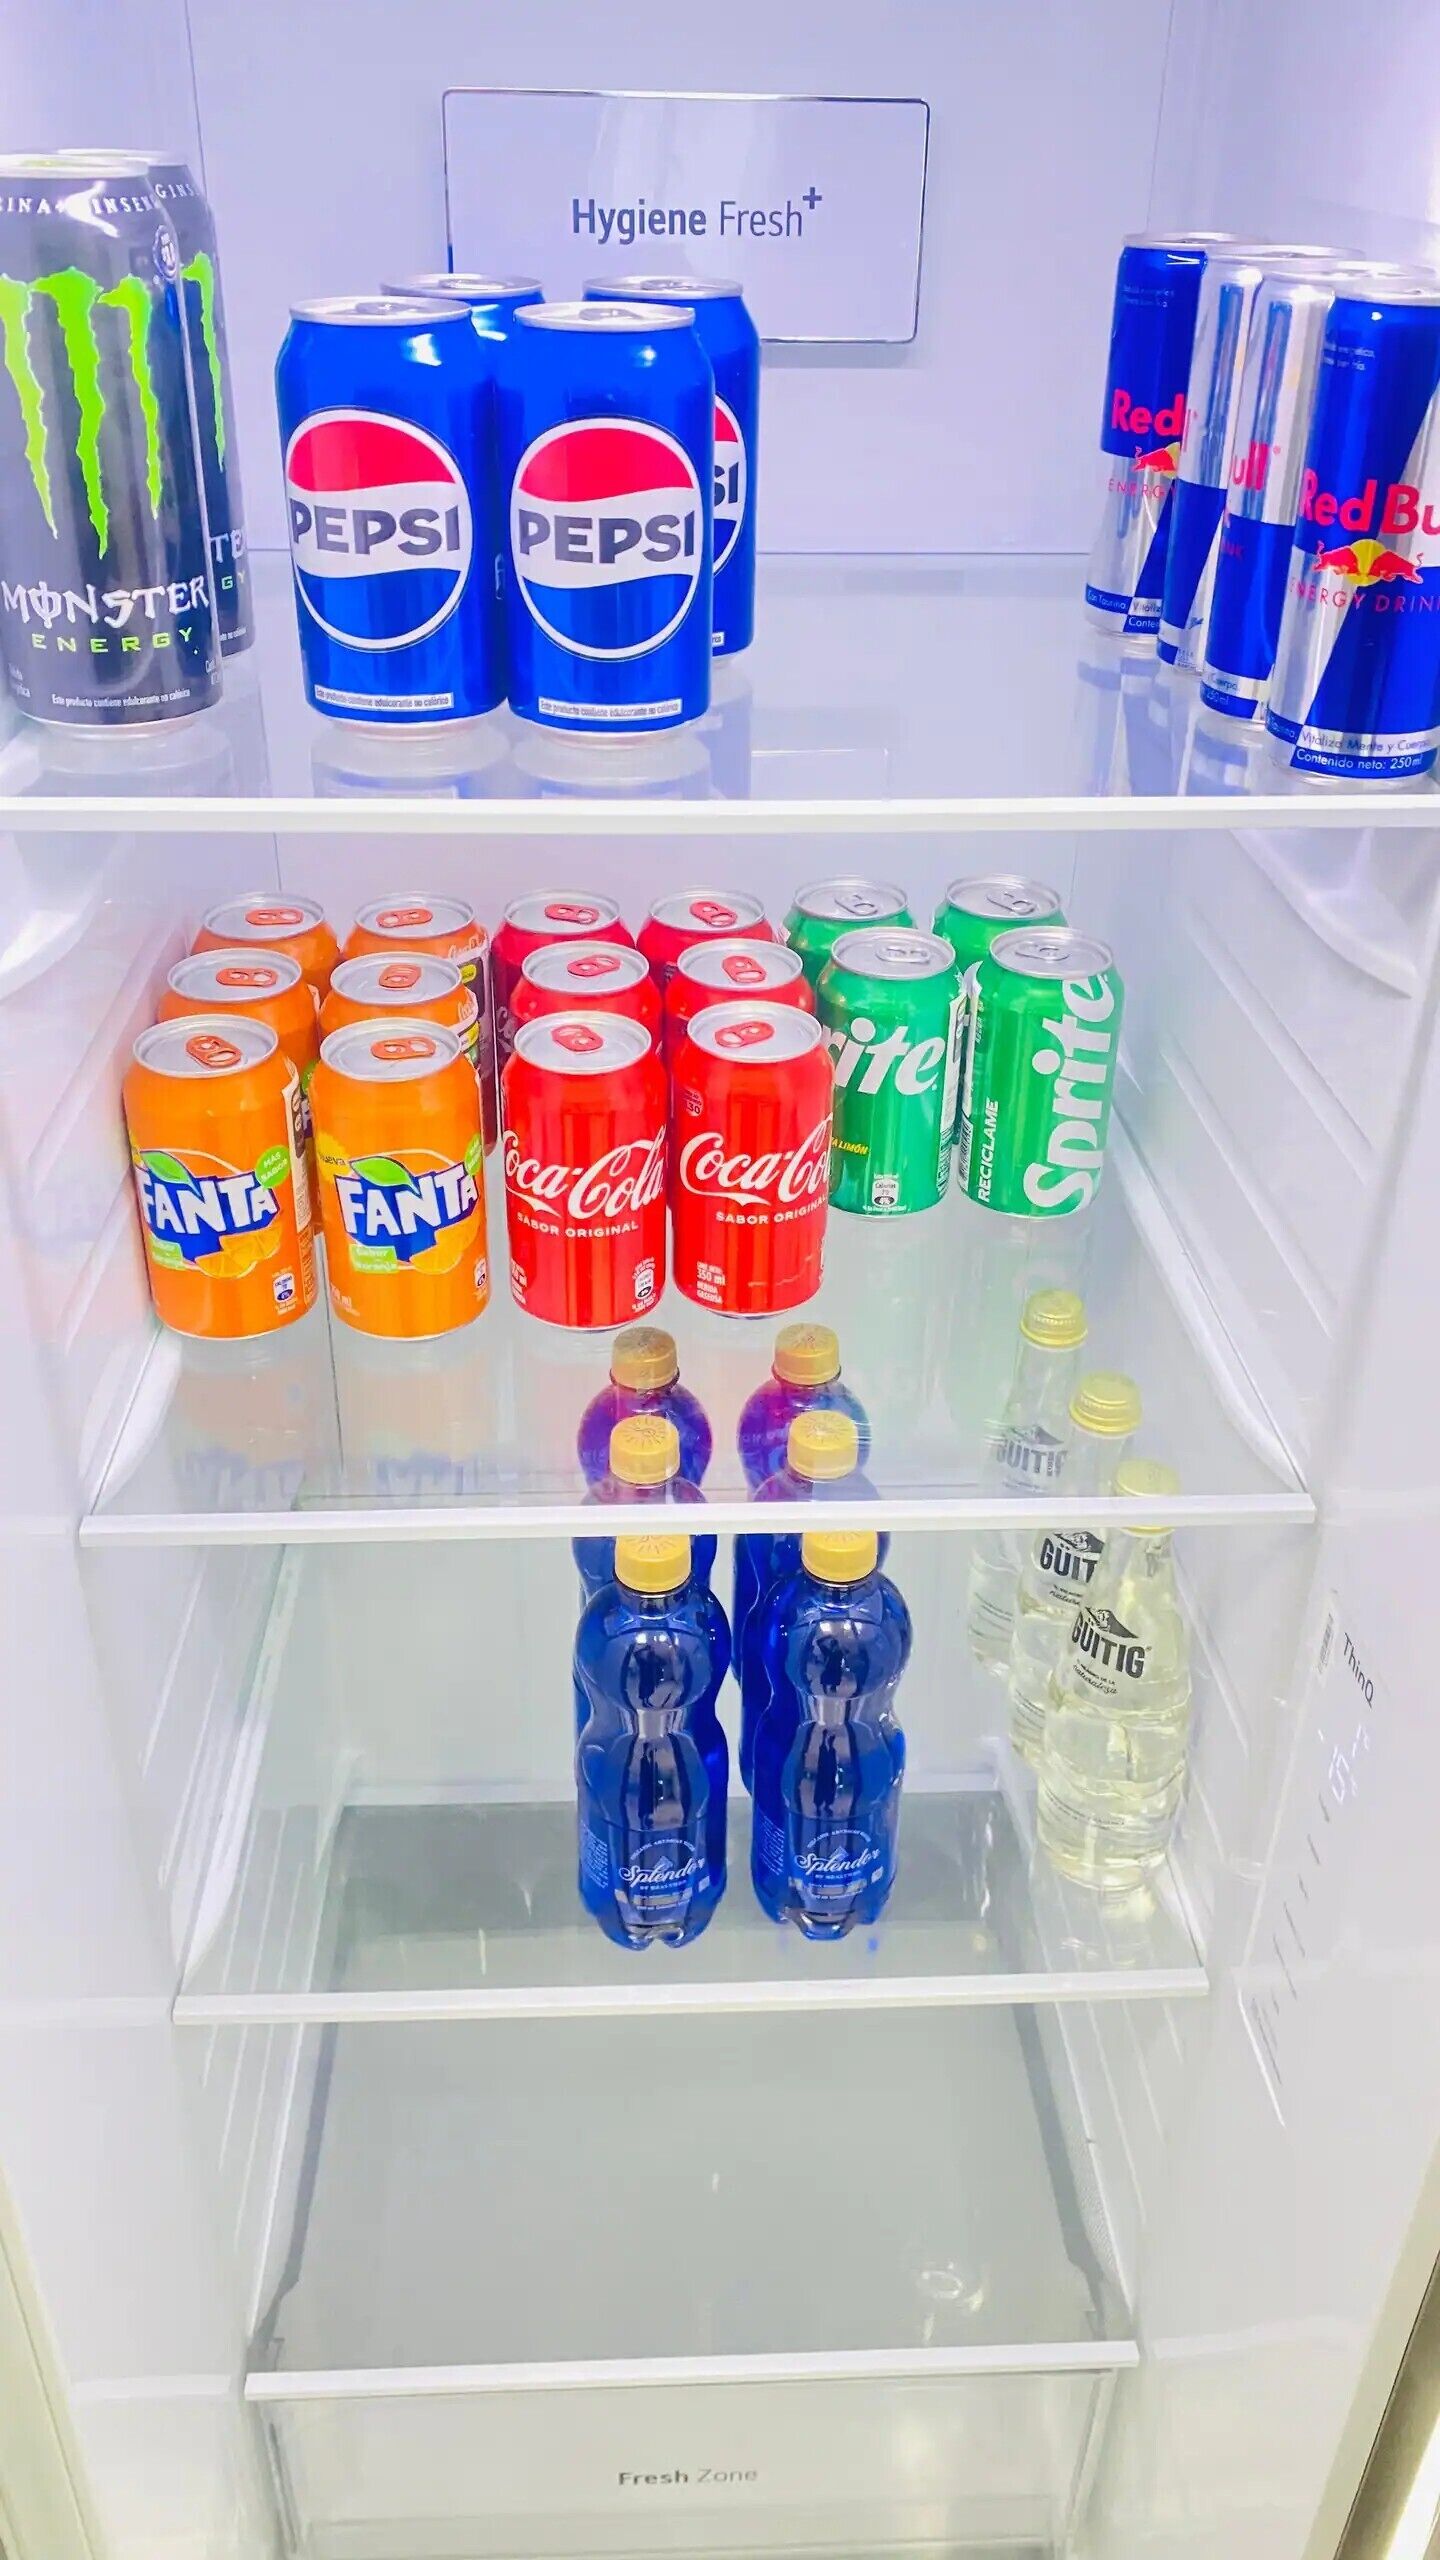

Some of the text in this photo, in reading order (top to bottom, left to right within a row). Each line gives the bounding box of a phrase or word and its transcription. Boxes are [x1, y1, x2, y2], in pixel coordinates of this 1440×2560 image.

[572, 199, 706, 245] Hygiene
[1111, 388, 1186, 438] Red
[1232, 441, 1270, 491] ull
[289, 497, 460, 556] PEPSI
[1300, 468, 1440, 536] Red Bu
[518, 507, 695, 564] PEPSI
[1, 575, 209, 629] MONSTER
[31, 626, 193, 653] ENERGY
[1296, 750, 1354, 769] Contenido
[1357, 760, 1386, 770] neto:
[1302, 731, 1343, 749] Vitaliza
[824, 1017, 946, 1096] rite
[1023, 974, 1116, 1210] Sprite
[977, 1098, 999, 1203] RECICLAME
[142, 1175, 278, 1236] FANTA
[336, 1163, 478, 1236] FANTA
[517, 1211, 639, 1238] SABOR ORIGINAL
[716, 1211, 769, 1225] SABOR
[1040, 1537, 1098, 1583] GÜIT
[1071, 1611, 1146, 1679] GÜITIG
[1344, 1632, 1374, 1709] ThinQ
[618, 2468, 758, 2486] Fresh Zone
